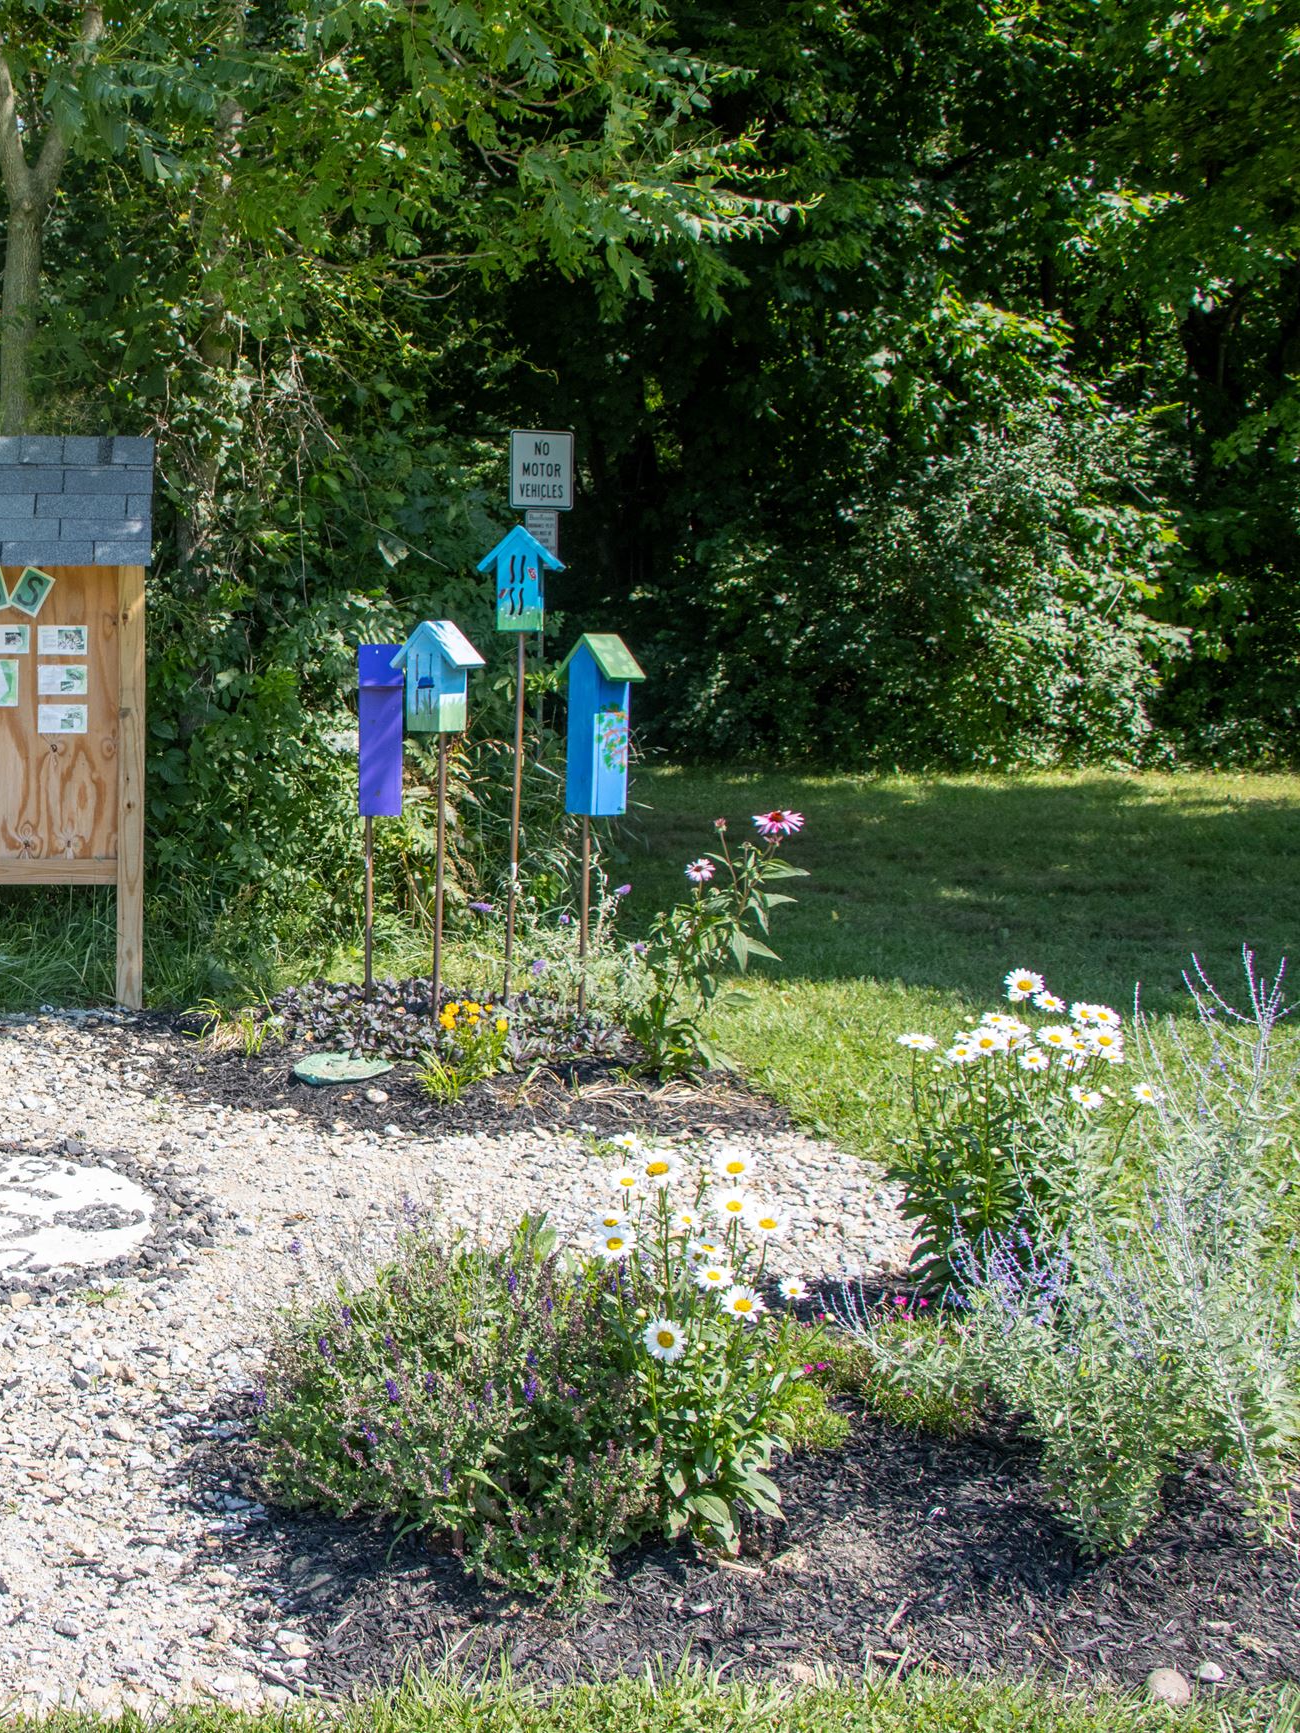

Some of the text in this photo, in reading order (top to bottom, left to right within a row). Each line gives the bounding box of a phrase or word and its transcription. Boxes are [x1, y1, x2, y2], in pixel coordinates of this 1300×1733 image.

[534, 441, 550, 457] NO
[522, 462, 562, 478] MOTOR
[519, 483, 564, 499] VEHICLES
